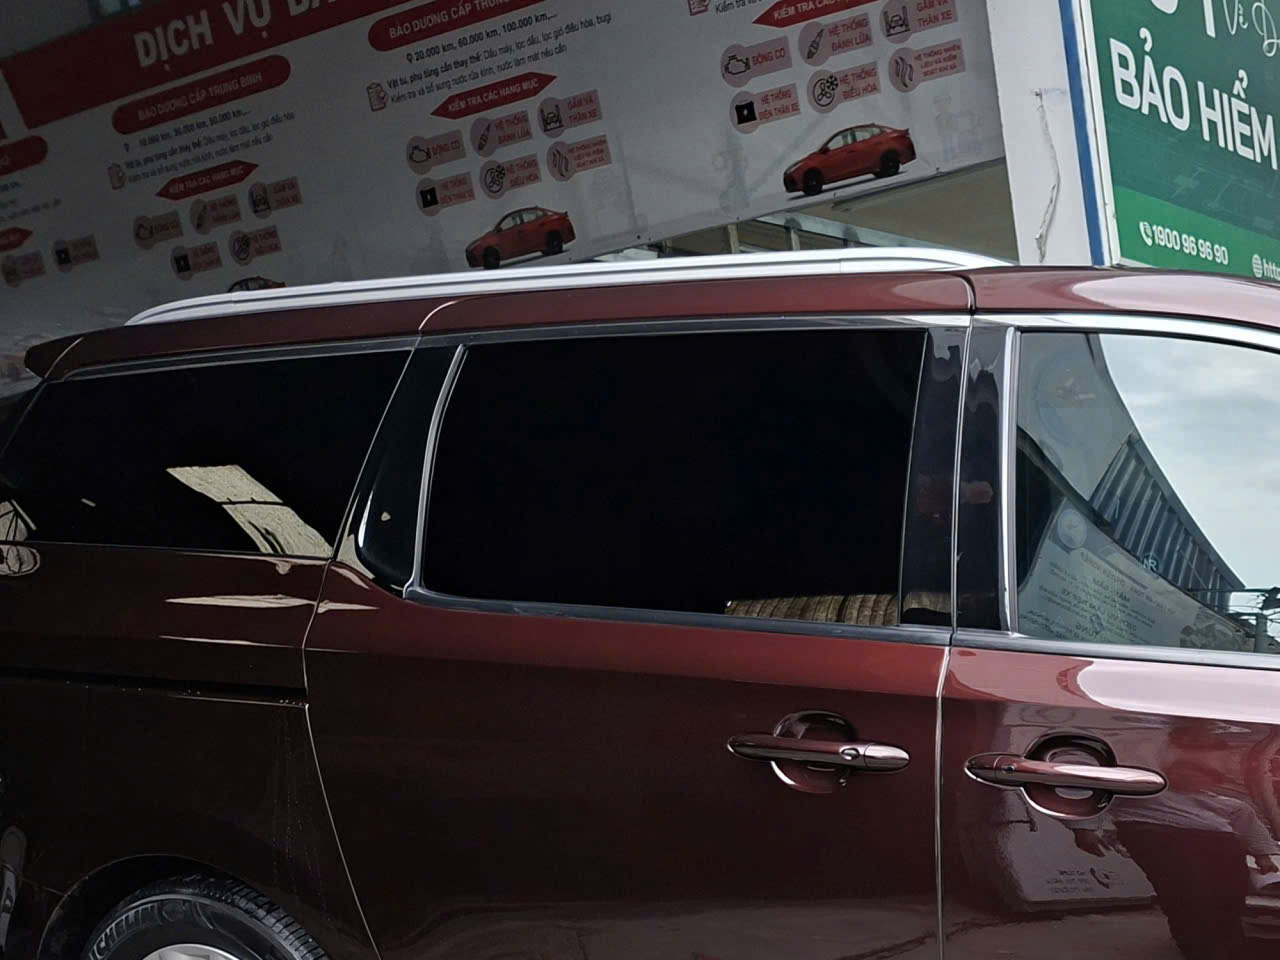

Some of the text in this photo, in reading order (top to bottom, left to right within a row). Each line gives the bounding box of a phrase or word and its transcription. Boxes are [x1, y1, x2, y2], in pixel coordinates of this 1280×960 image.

[797, 1, 815, 13] TRA
[133, 0, 272, 71] DỊCH VỤ
[414, 46, 440, 60] 20.000
[503, 16, 533, 33] 100.000
[1110, 27, 1191, 132] BẢO
[1197, 69, 1278, 171] HIỂM
[1152, 223, 1229, 266] 1900 96 96 90
